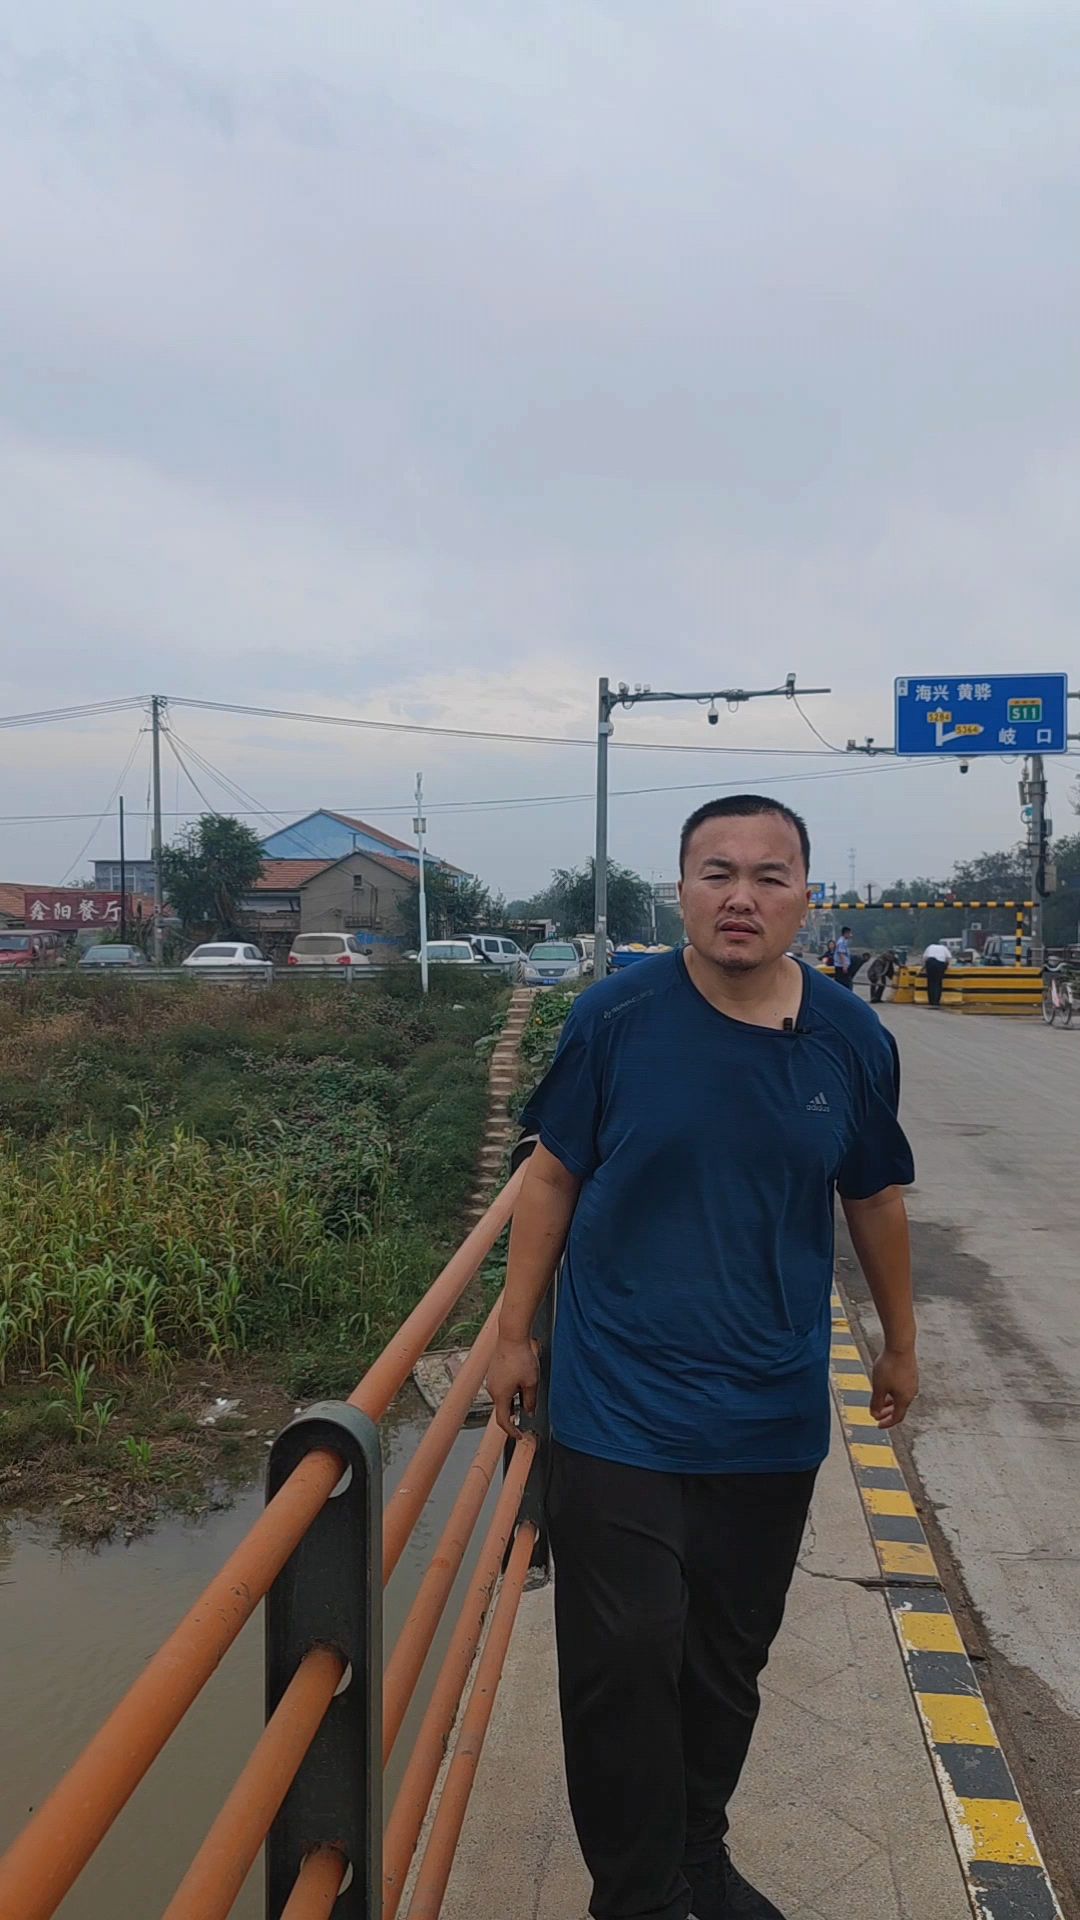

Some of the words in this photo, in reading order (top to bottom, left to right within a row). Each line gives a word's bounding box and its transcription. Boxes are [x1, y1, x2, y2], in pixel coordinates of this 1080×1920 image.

[915, 685, 949, 702] 海兴
[957, 684, 992, 701] 黄骅
[1012, 707, 1037, 720] S11
[30, 899, 122, 921] 鑫阳餐厅
